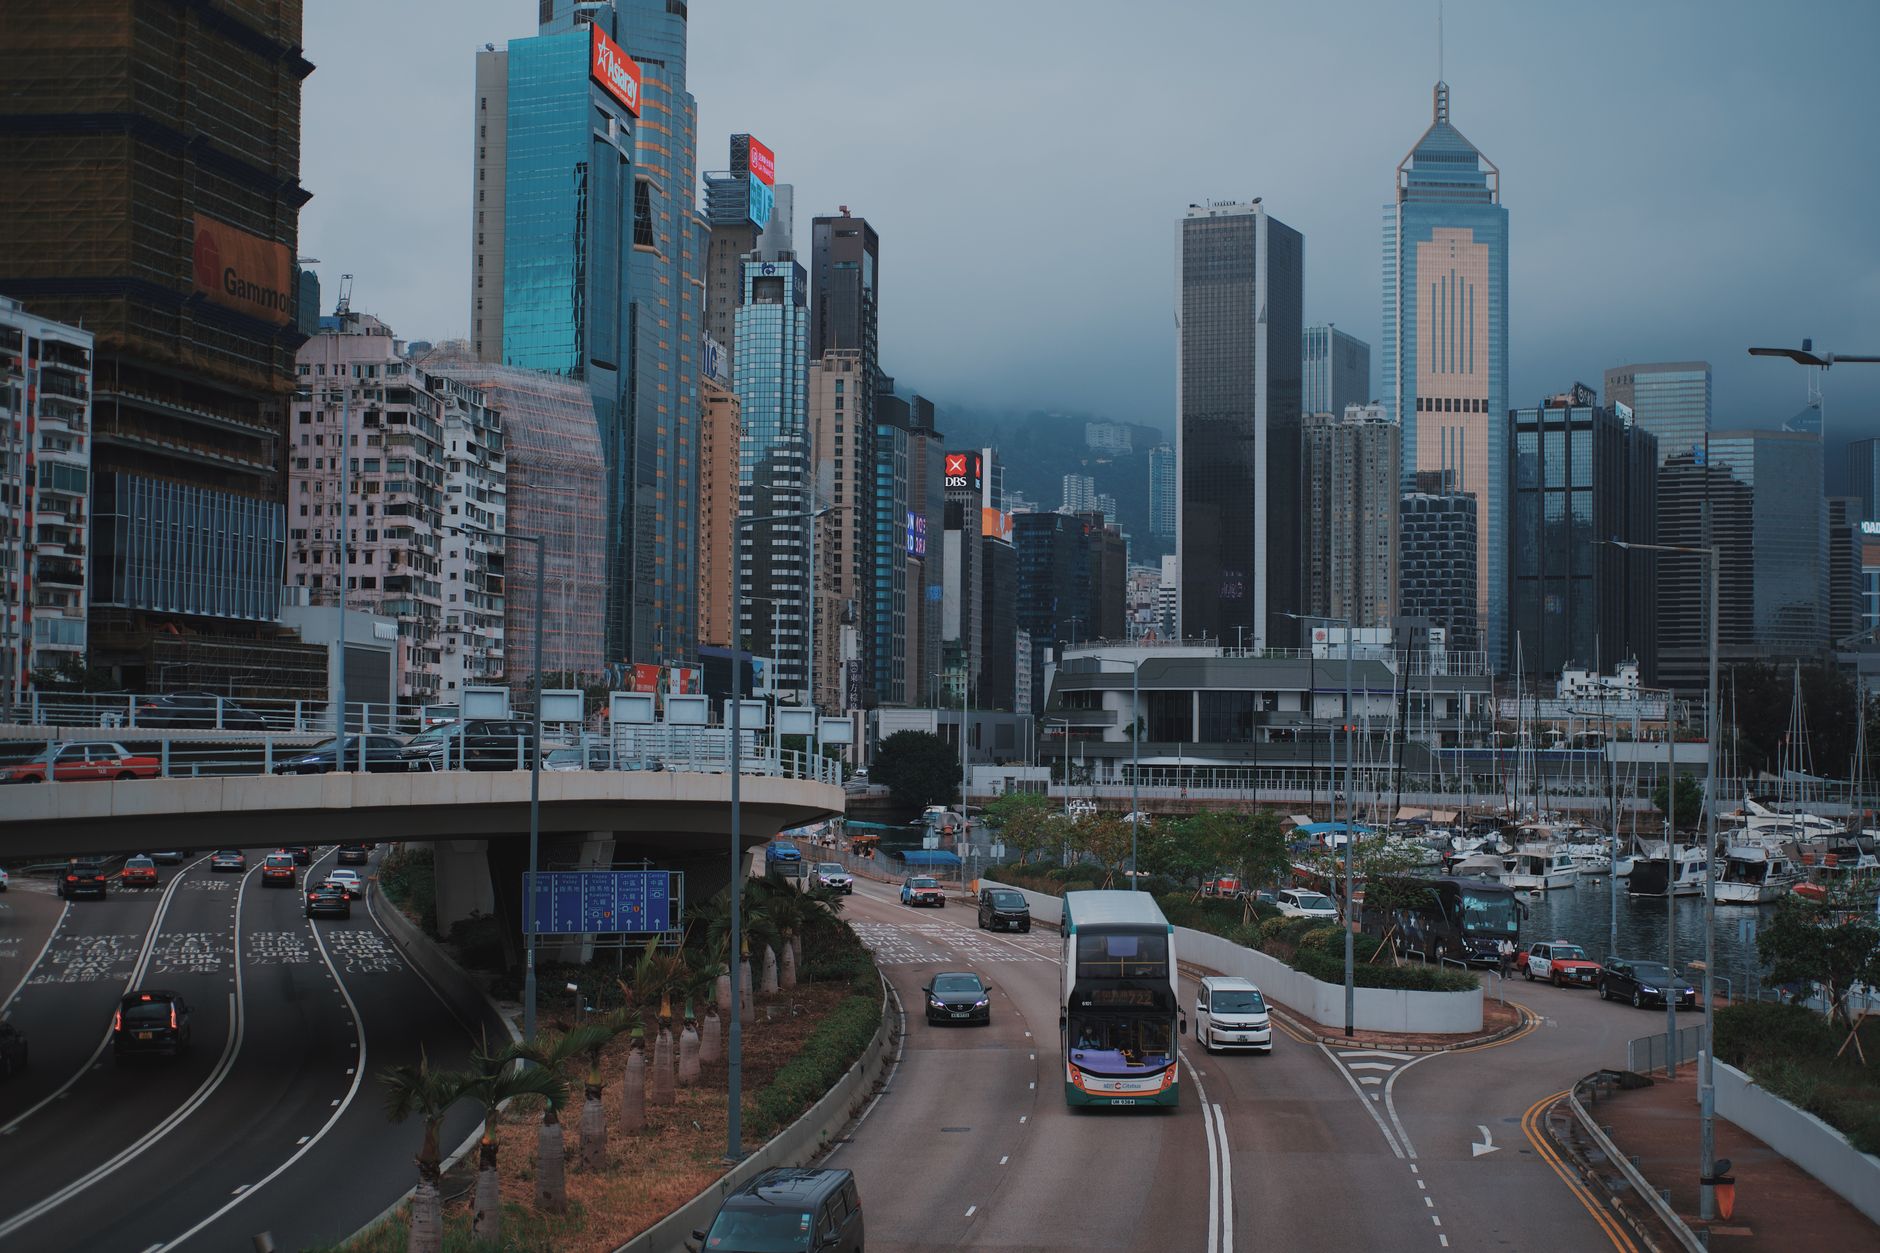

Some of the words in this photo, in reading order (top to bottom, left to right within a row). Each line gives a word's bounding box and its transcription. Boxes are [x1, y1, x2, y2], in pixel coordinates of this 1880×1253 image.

[608, 50, 638, 109] Asiaray
[945, 476, 967, 487] DBS
[1127, 991, 1153, 1005] 722
